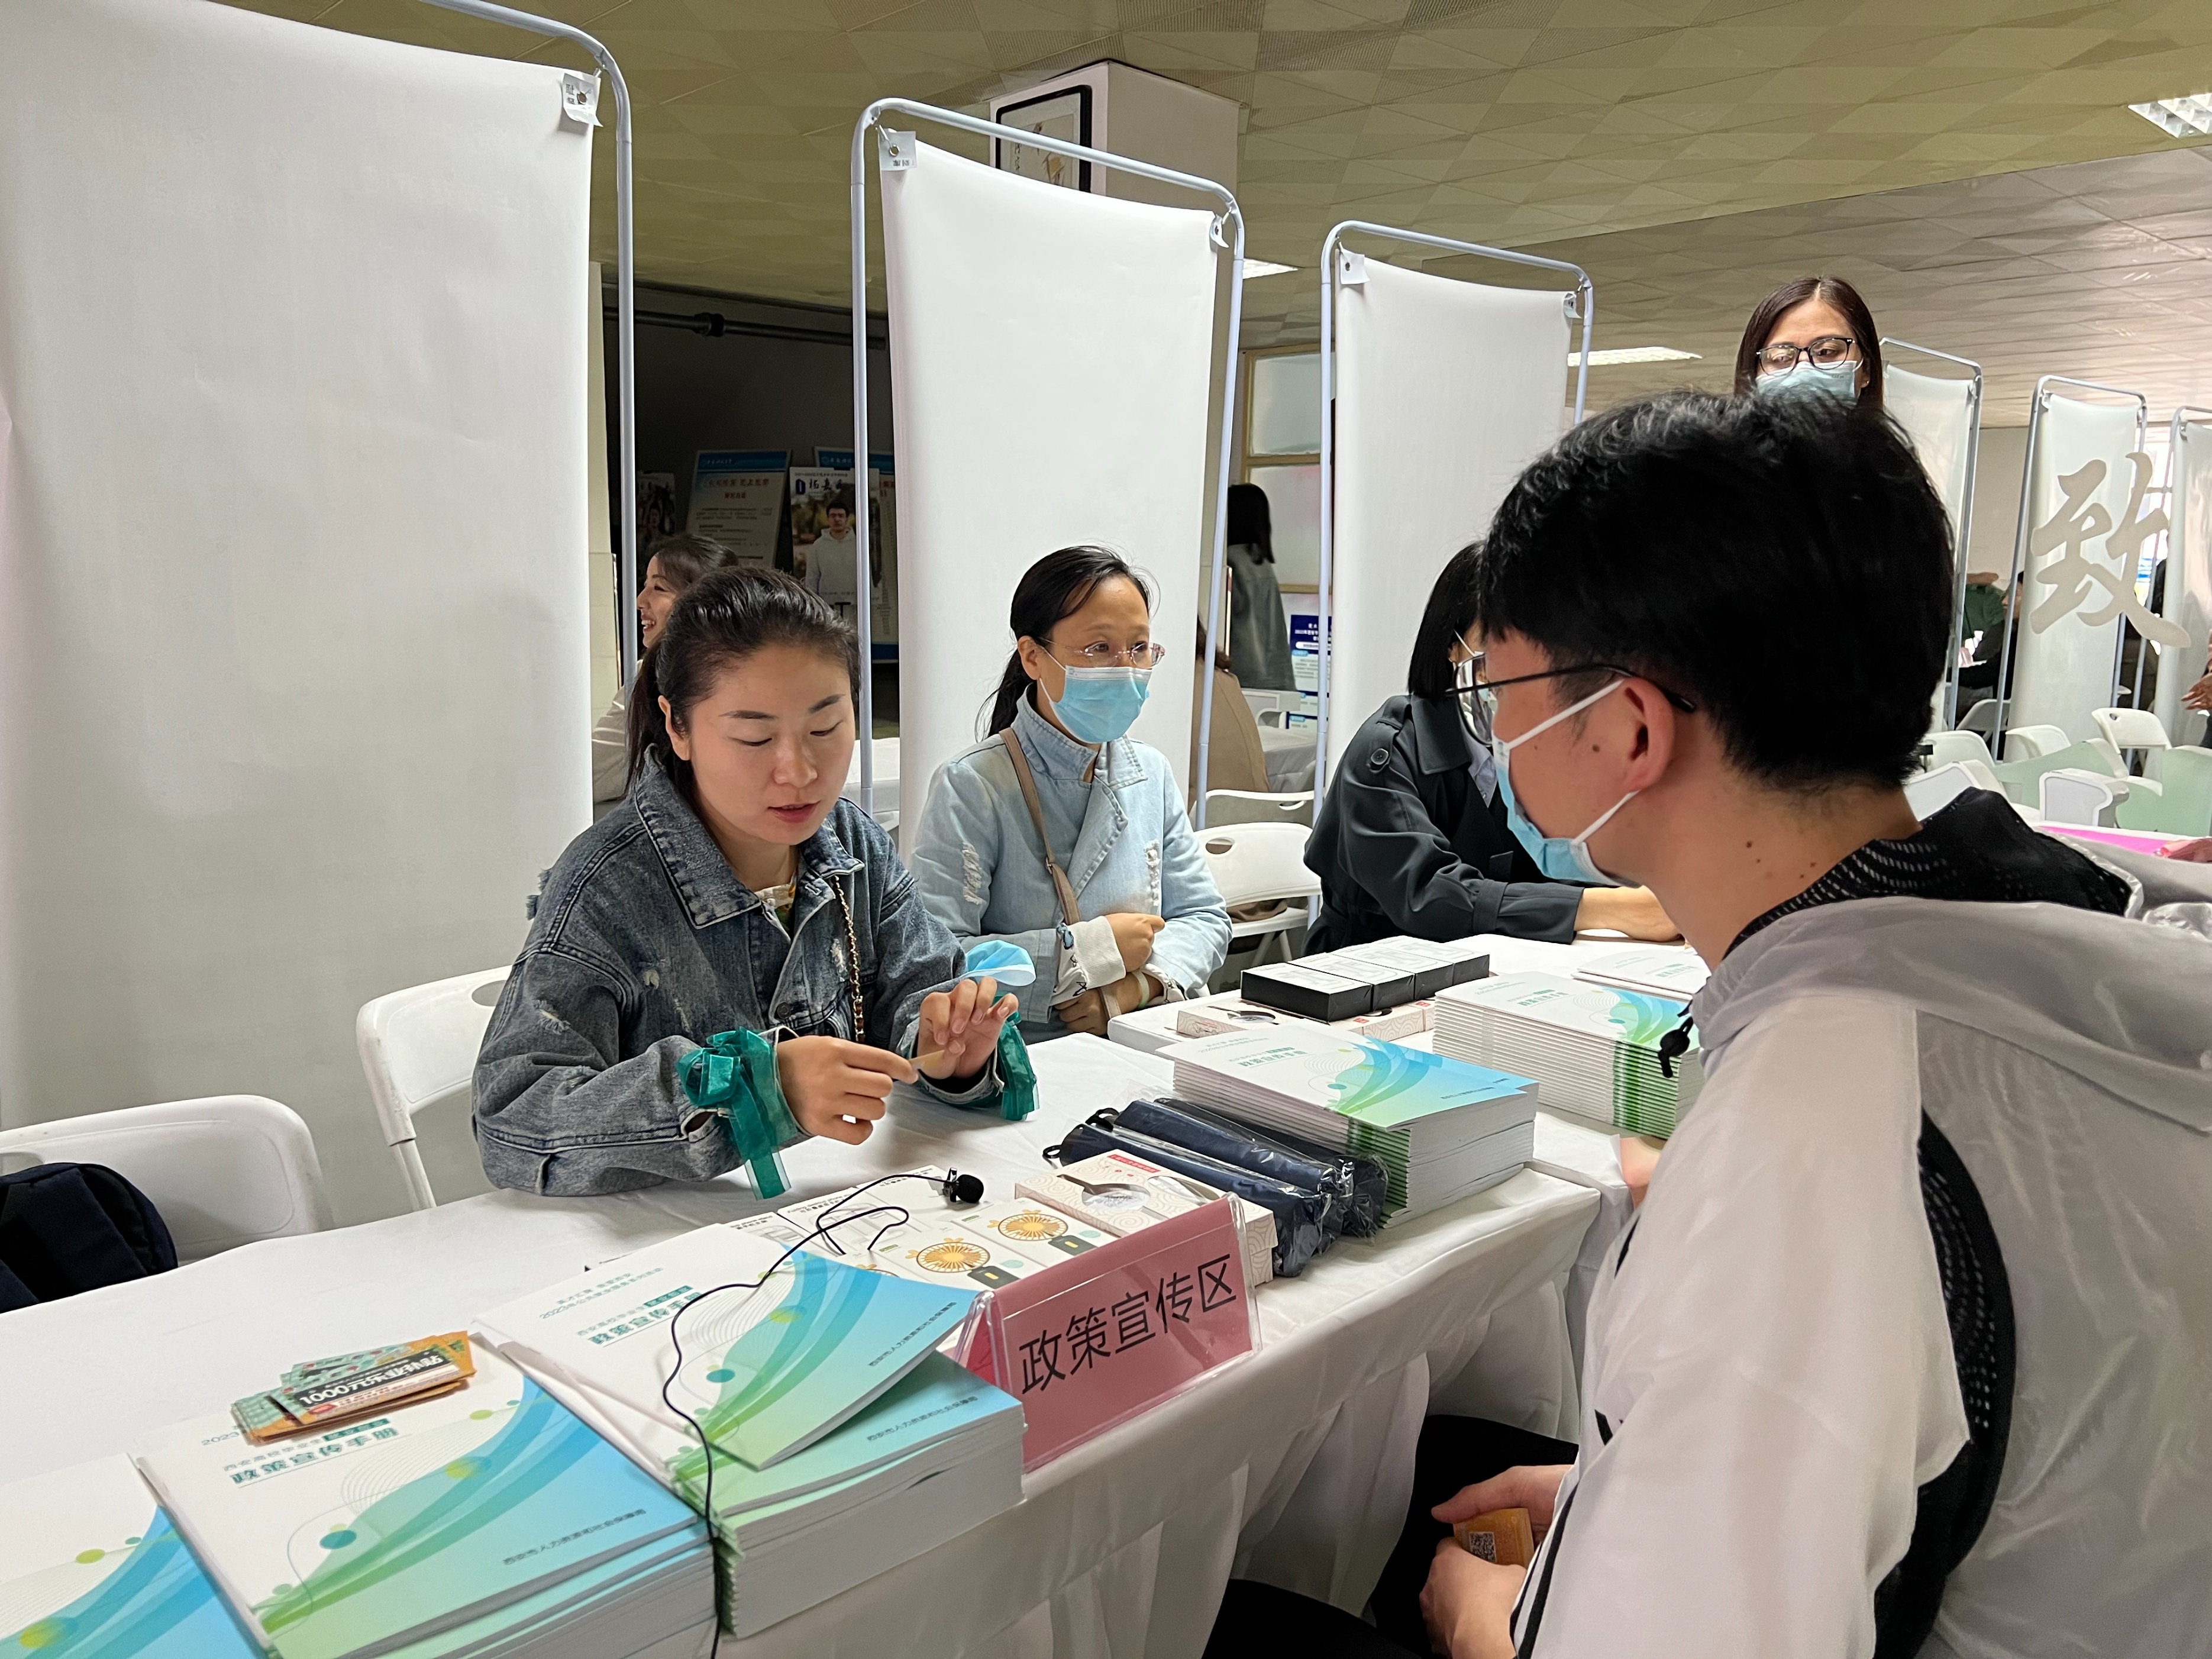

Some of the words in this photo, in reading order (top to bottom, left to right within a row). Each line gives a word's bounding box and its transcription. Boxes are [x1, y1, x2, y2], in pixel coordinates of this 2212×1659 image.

[1019, 1254, 1236, 1395] 政策宣传区
[230, 1426, 399, 1484] 政策宣传手册
